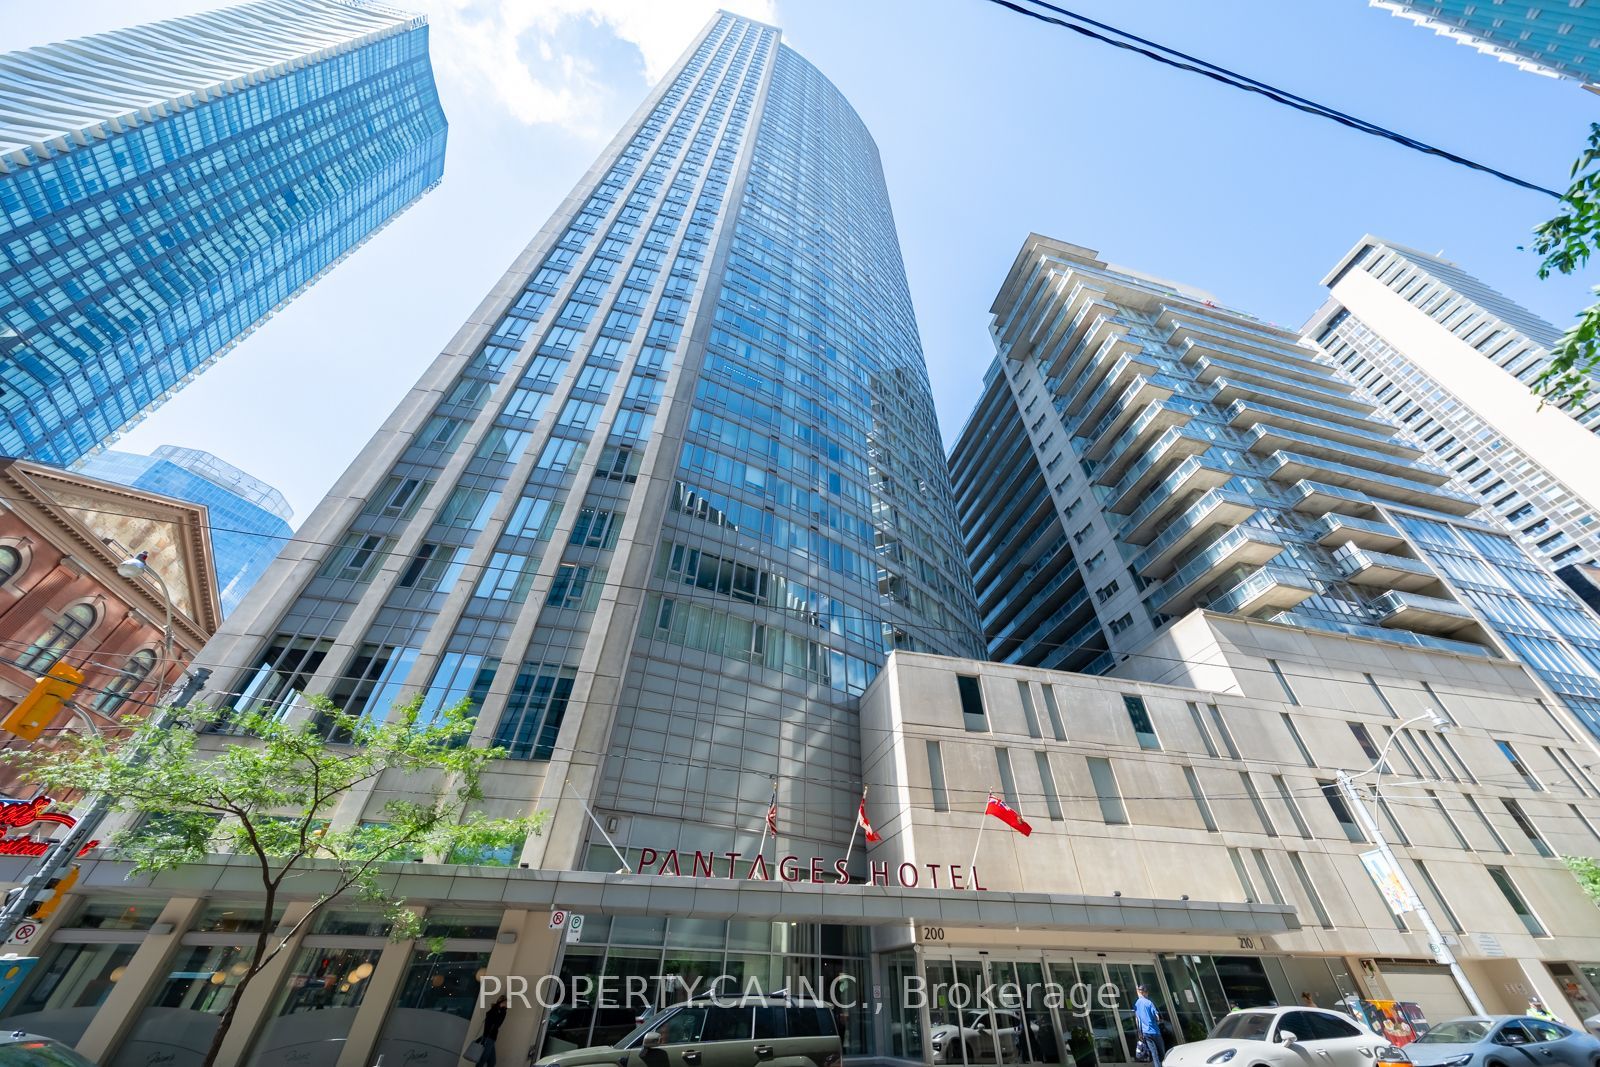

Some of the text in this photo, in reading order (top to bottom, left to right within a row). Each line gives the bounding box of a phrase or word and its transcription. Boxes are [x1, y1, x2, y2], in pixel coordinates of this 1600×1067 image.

[637, 847, 988, 891] PANTAGES HOTEL
[924, 927, 945, 940] 200
[1237, 936, 1254, 949] 210
